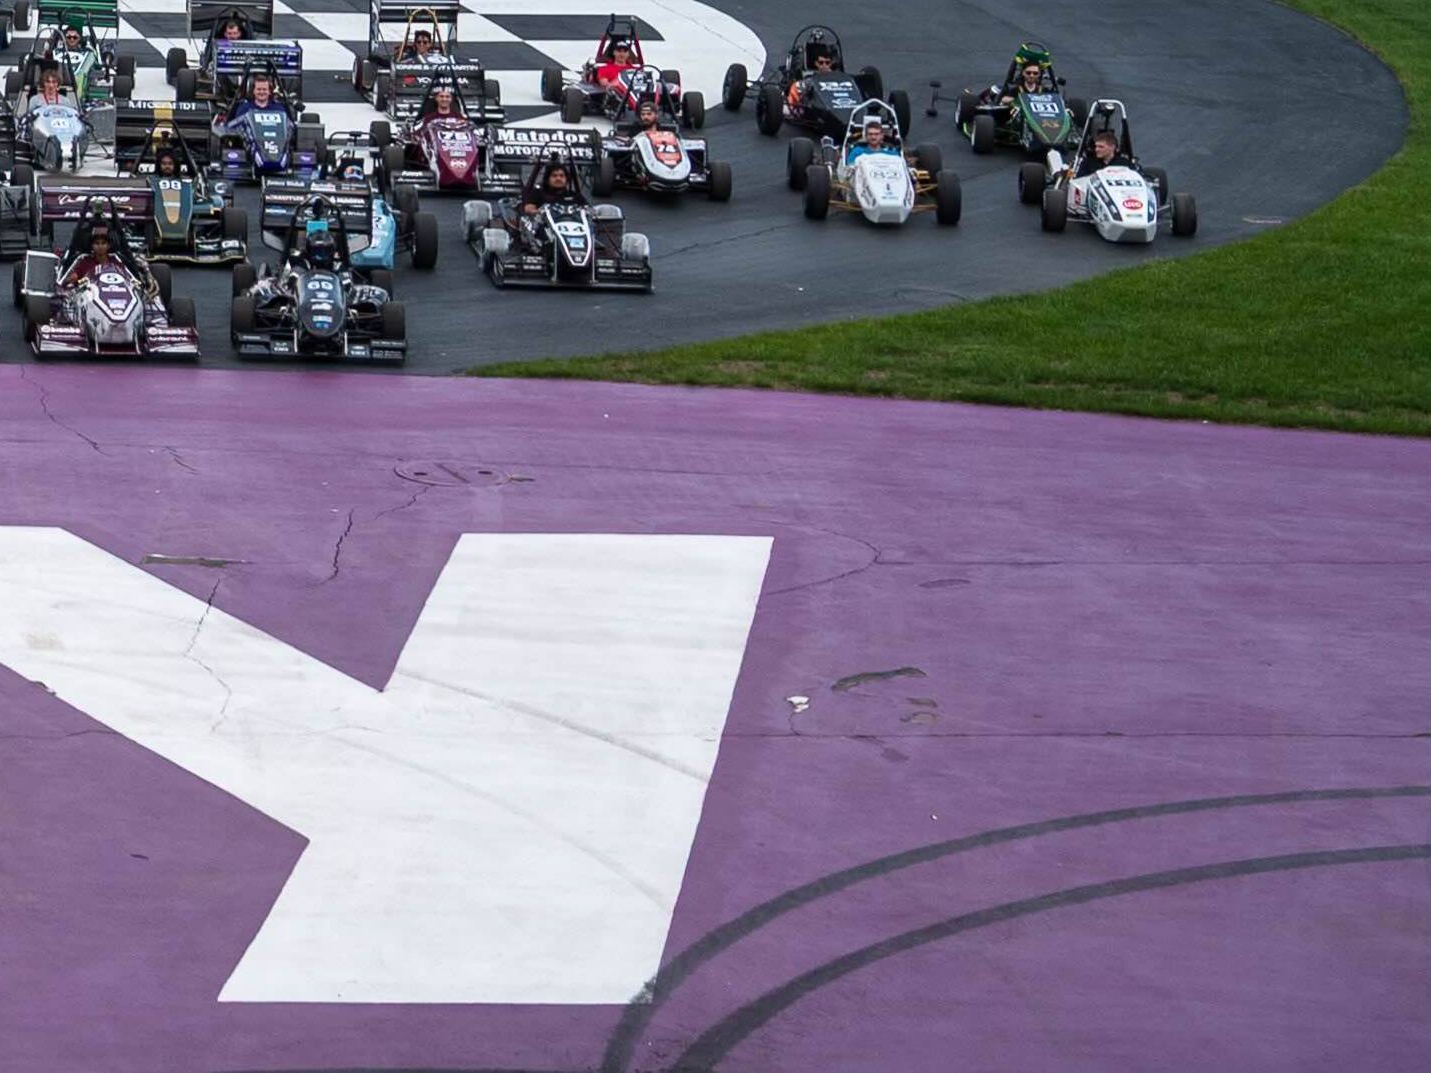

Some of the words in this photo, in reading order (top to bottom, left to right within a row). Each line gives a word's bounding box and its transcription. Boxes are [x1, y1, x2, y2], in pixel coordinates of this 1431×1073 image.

[498, 128, 589, 144] Matador
[159, 180, 182, 189] 98
[308, 281, 334, 290] 69
